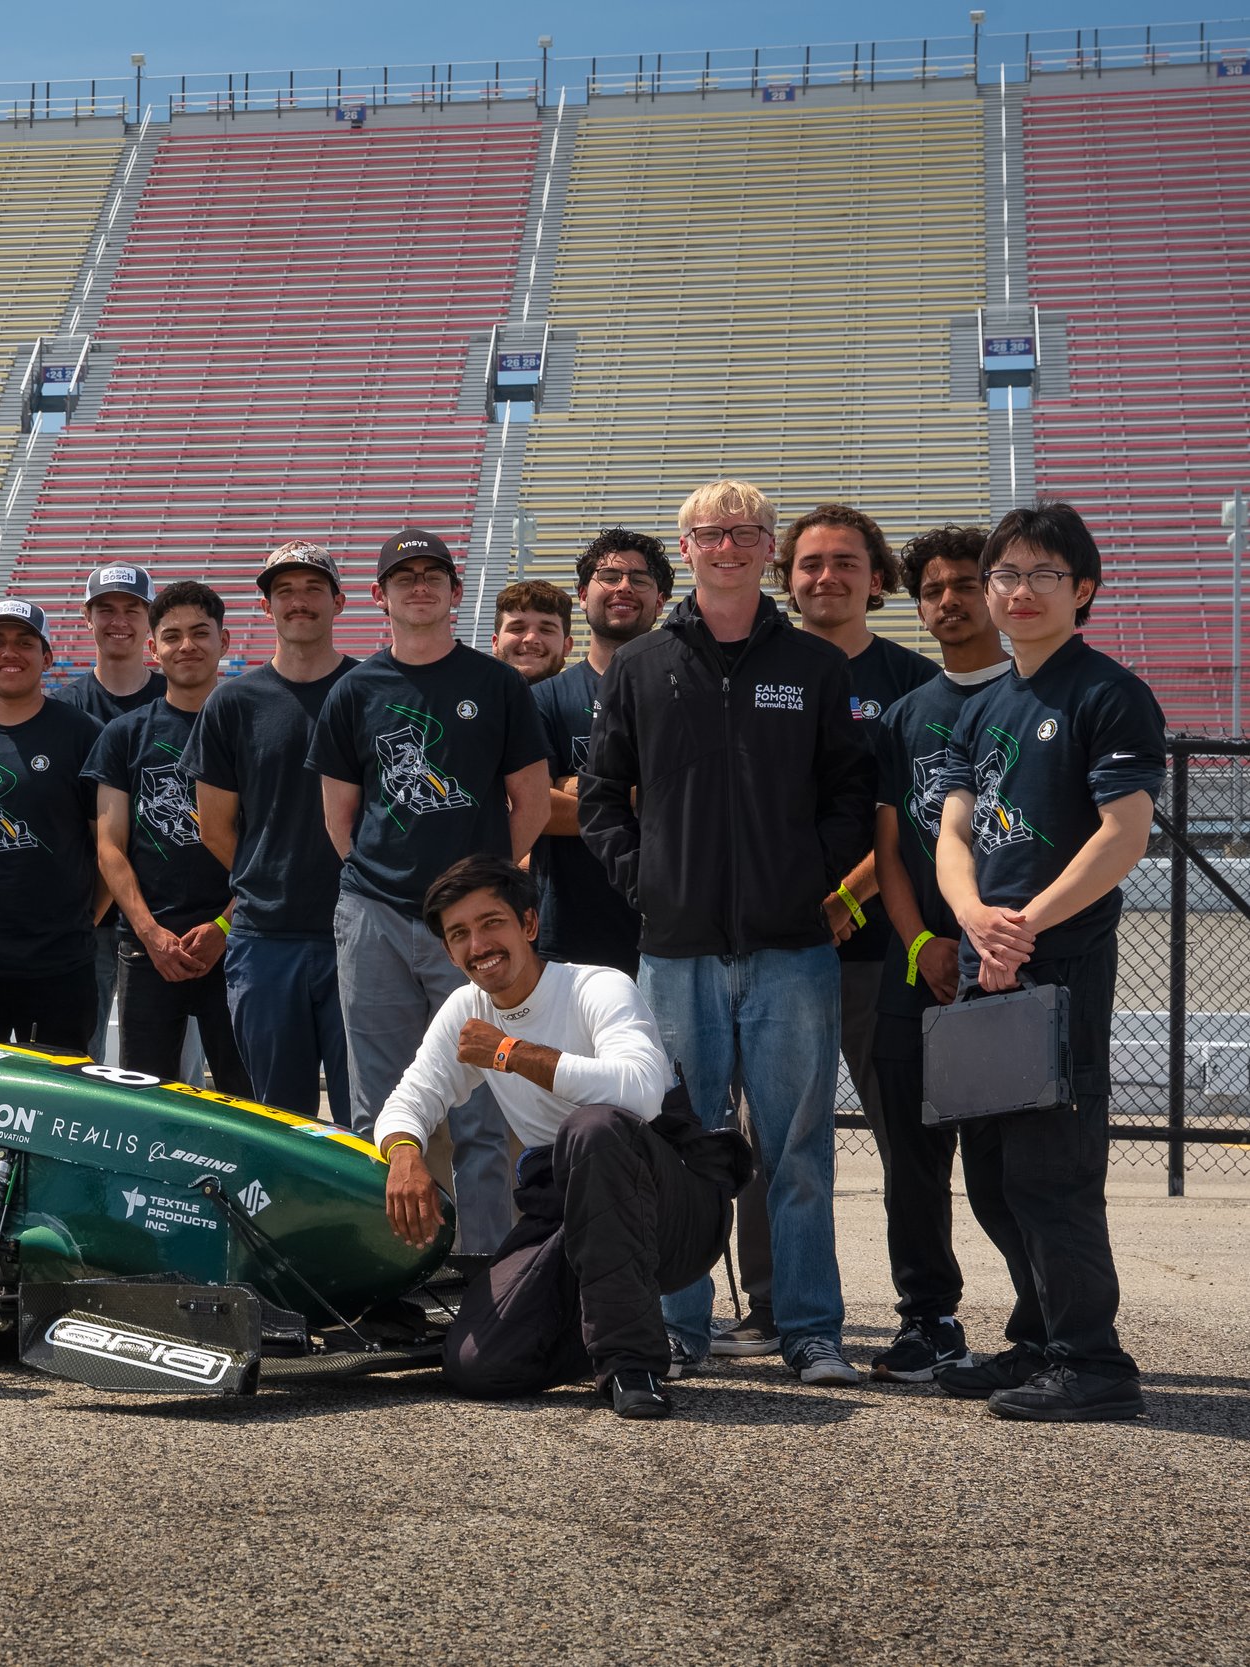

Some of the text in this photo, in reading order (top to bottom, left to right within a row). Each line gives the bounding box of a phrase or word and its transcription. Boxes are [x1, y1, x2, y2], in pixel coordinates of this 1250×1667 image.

[1226, 66, 1243, 76] 30
[772, 92, 786, 101] 28
[344, 112, 358, 120] 26
[1010, 343, 1025, 351] 30
[507, 358, 536, 368] 26 28
[50, 370, 63, 379] 24
[398, 540, 429, 551] Ansys
[102, 573, 134, 583] Bosch
[756, 684, 804, 695] CAL POLY
[755, 692, 803, 704] POMONA
[755, 701, 804, 711] Formula SAE
[51, 1118, 139, 1154] REALIS
[170, 1149, 238, 1173] BOEING
[150, 1196, 200, 1214] TEXTILE
[147, 1208, 218, 1230] PRODUCTS
[145, 1219, 170, 1233] INC.
